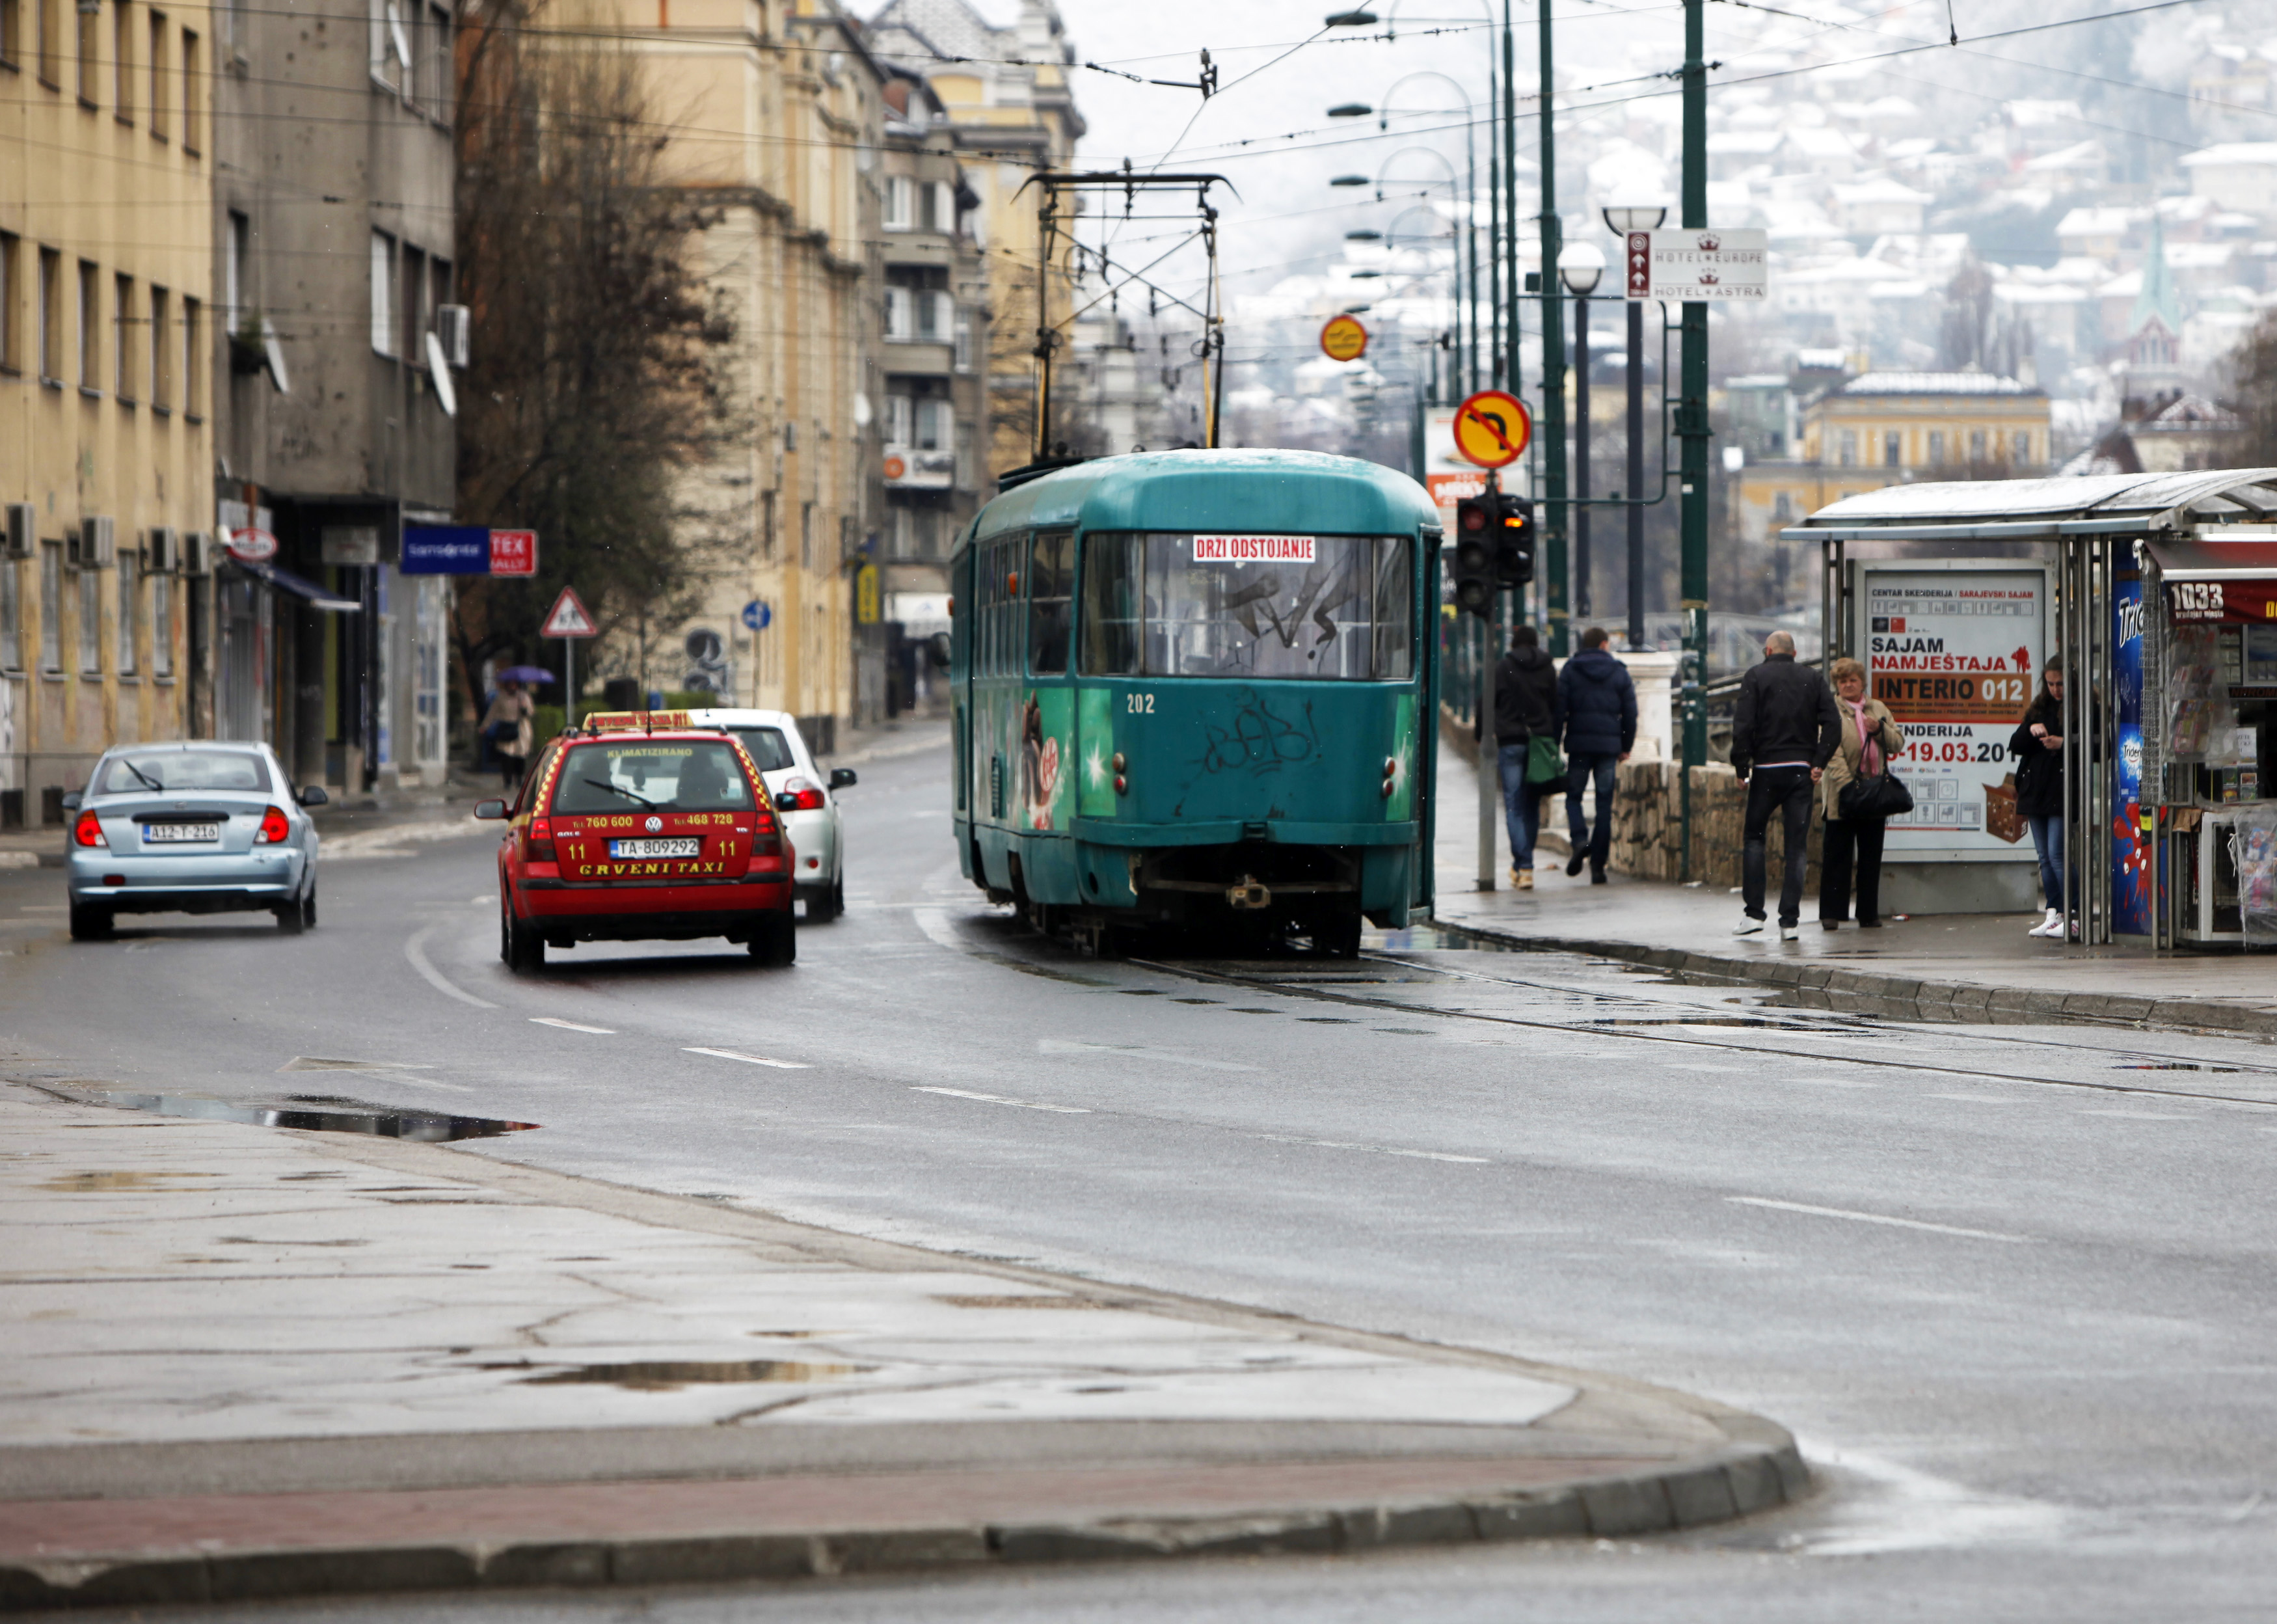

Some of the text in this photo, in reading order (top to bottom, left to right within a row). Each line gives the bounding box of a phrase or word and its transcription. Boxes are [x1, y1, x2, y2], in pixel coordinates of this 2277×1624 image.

[1655, 252, 1762, 263] HOTEL EUROPE
[1655, 286, 1703, 297] HOTEL
[1714, 286, 1763, 297] ASTRA
[1196, 536, 1313, 558] DRŽI ODSTOJANJE
[1872, 589, 1902, 597] CENTAR
[1905, 589, 1953, 598] SKENDERIJA
[1959, 590, 2006, 599] SARAJEVSKI
[2008, 590, 2034, 599] SAJAM
[2171, 582, 2224, 610] 1033
[1872, 637, 1944, 653] SAJAM
[1871, 652, 2007, 671] NAMJEŠTAJA
[1878, 678, 2024, 701] INTERIO 012
[1127, 693, 1155, 714] 202
[607, 748, 694, 759] KLIMATIZIRANO
[586, 817, 607, 828] 760
[611, 816, 634, 828] 600
[686, 814, 708, 825] 468
[712, 814, 733, 825] 728
[151, 827, 215, 839] A12-T-216
[568, 843, 585, 860] 11
[619, 839, 697, 854] TA-809292
[719, 839, 735, 857] 11
[678, 861, 725, 874] TAXI
